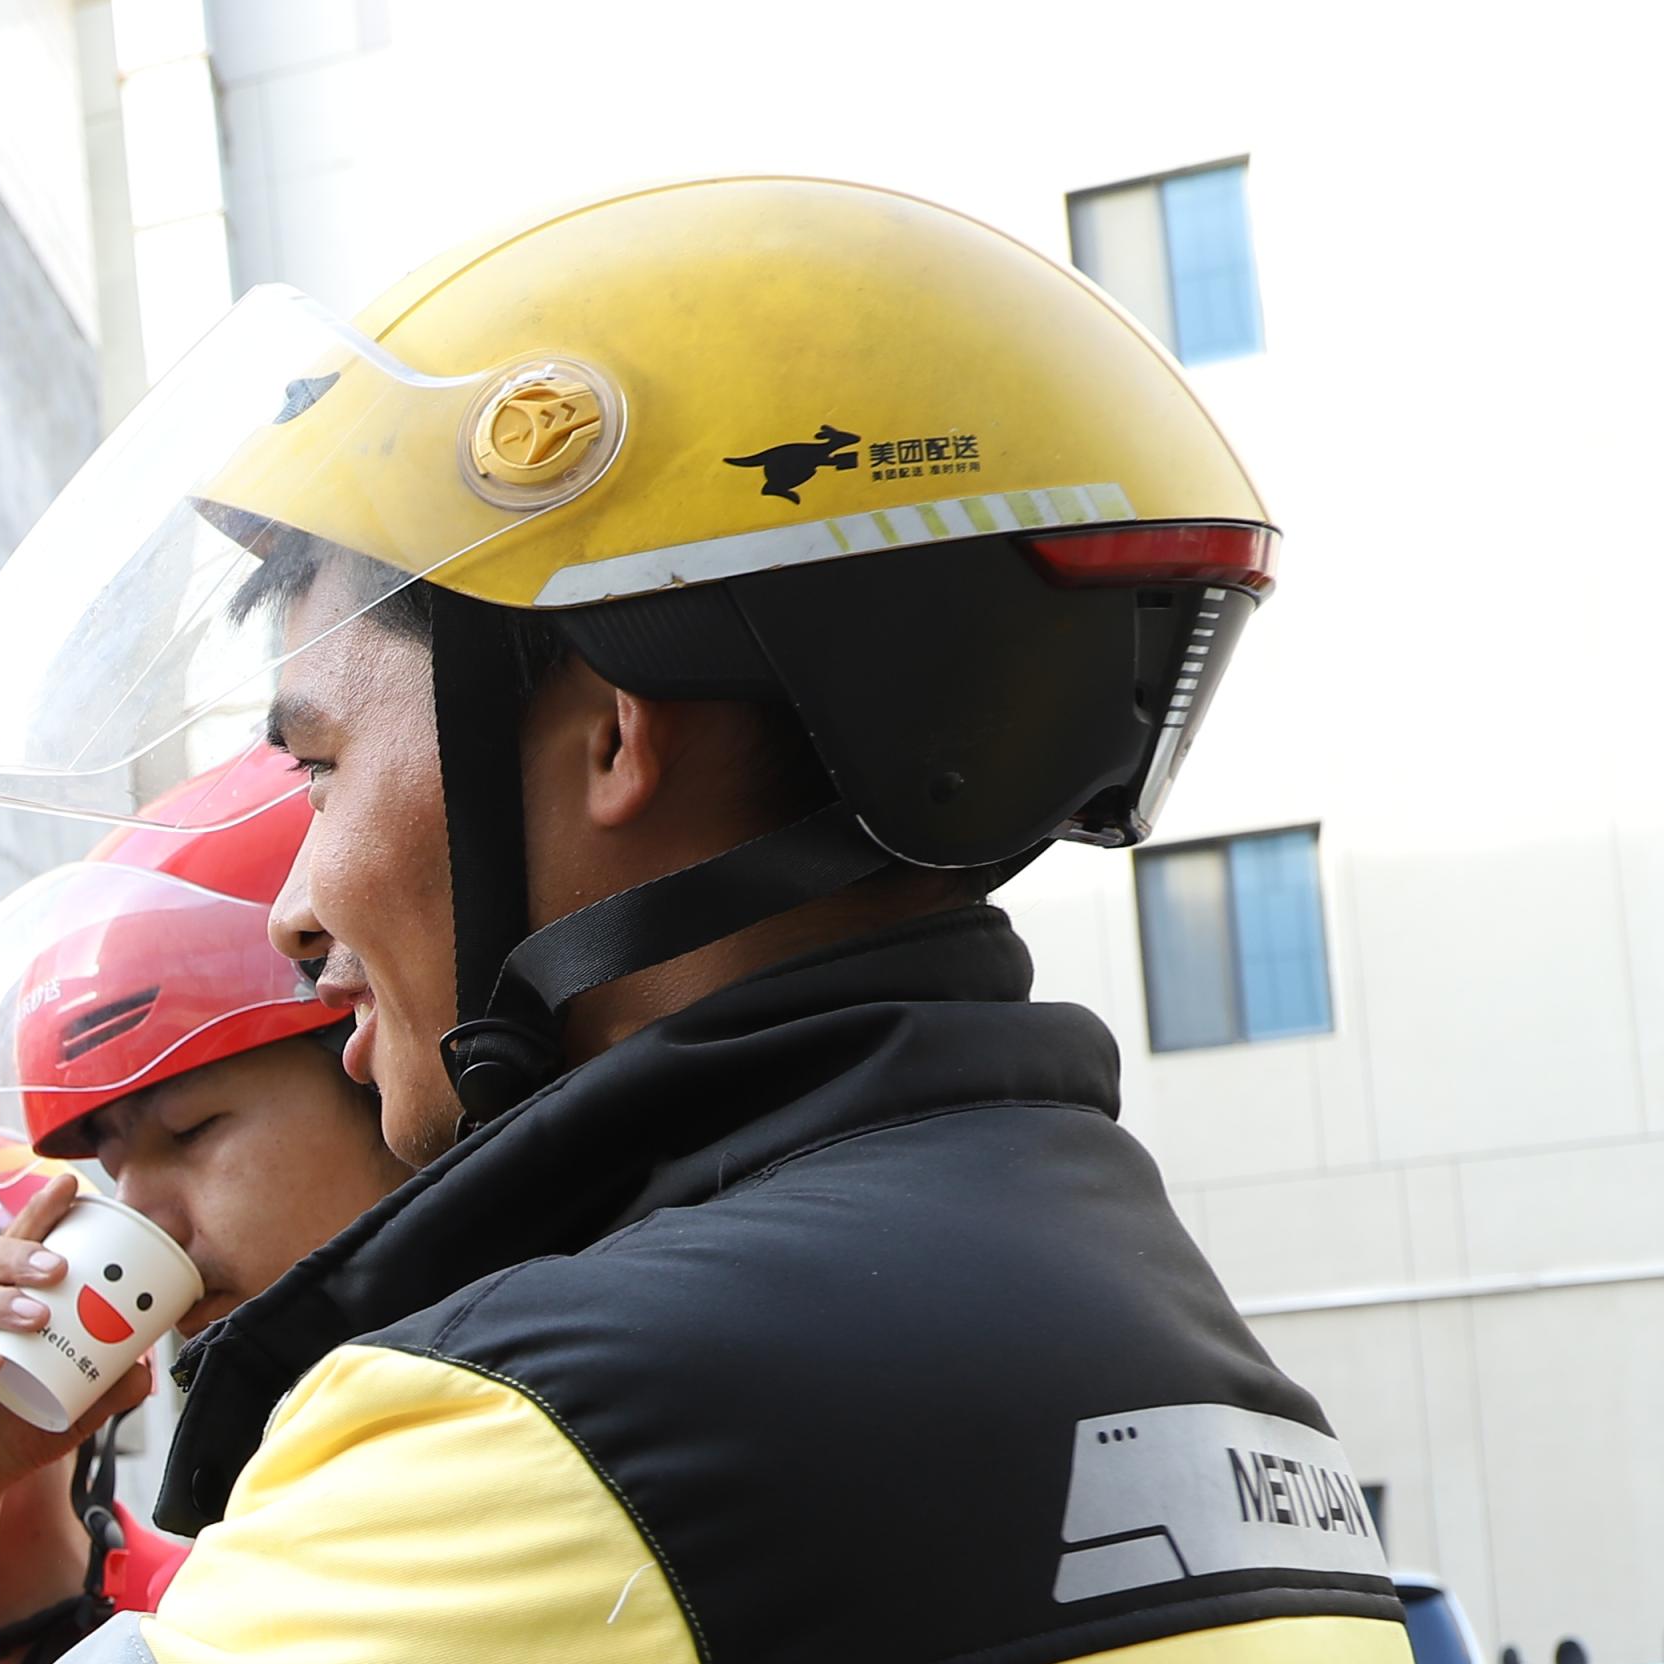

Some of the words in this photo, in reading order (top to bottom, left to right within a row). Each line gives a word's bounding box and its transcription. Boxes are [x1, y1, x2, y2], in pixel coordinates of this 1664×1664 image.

[869, 435, 979, 468] 美团配送
[1225, 1447, 1369, 1537] MEITUAN
